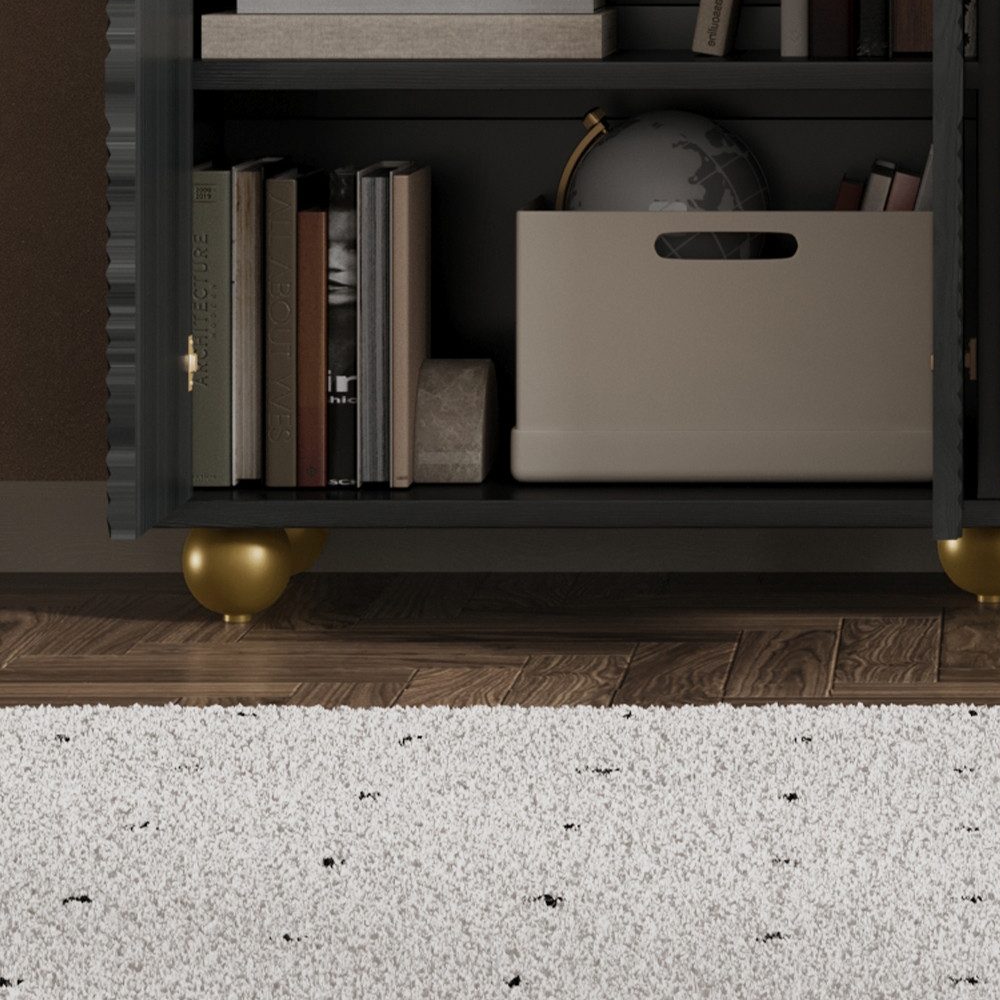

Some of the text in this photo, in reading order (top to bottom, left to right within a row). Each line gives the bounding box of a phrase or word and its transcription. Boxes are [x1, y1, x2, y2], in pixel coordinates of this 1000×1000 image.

[268, 192, 293, 247] ALL
[192, 233, 208, 387] ARCHITECTURE
[268, 256, 293, 358] ABOUT
